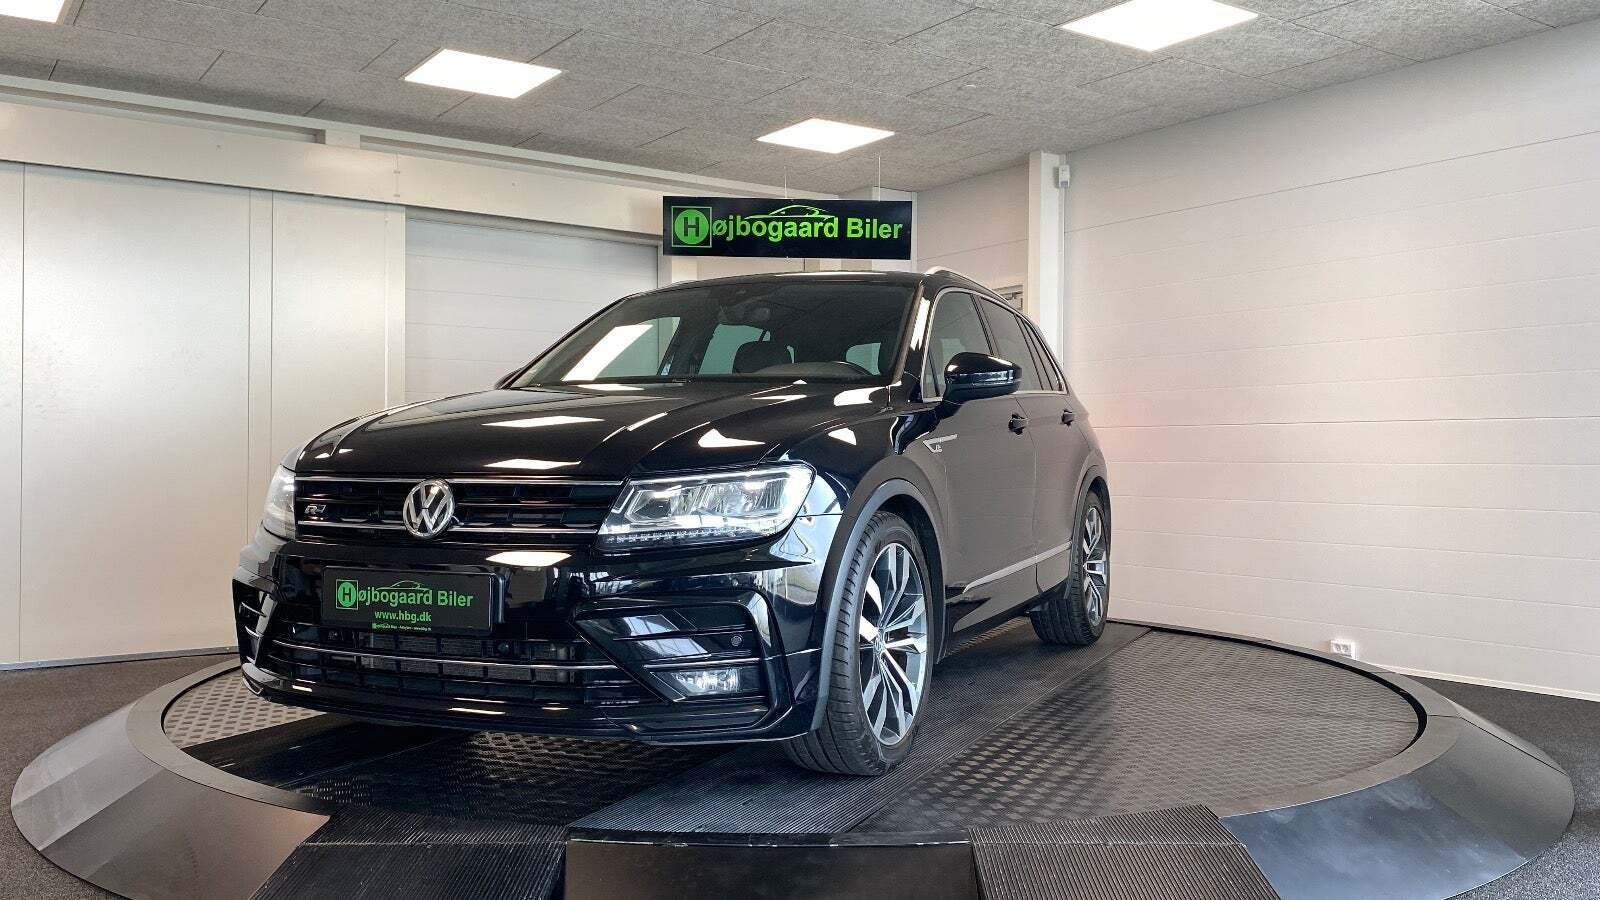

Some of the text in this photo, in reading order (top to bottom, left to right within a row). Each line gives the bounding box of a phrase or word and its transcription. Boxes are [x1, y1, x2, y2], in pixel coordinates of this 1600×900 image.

[675, 210, 903, 244] Højbogaard Biler
[338, 583, 474, 608] Højbogaard Biler
[374, 610, 432, 624] www.hbg.dk
